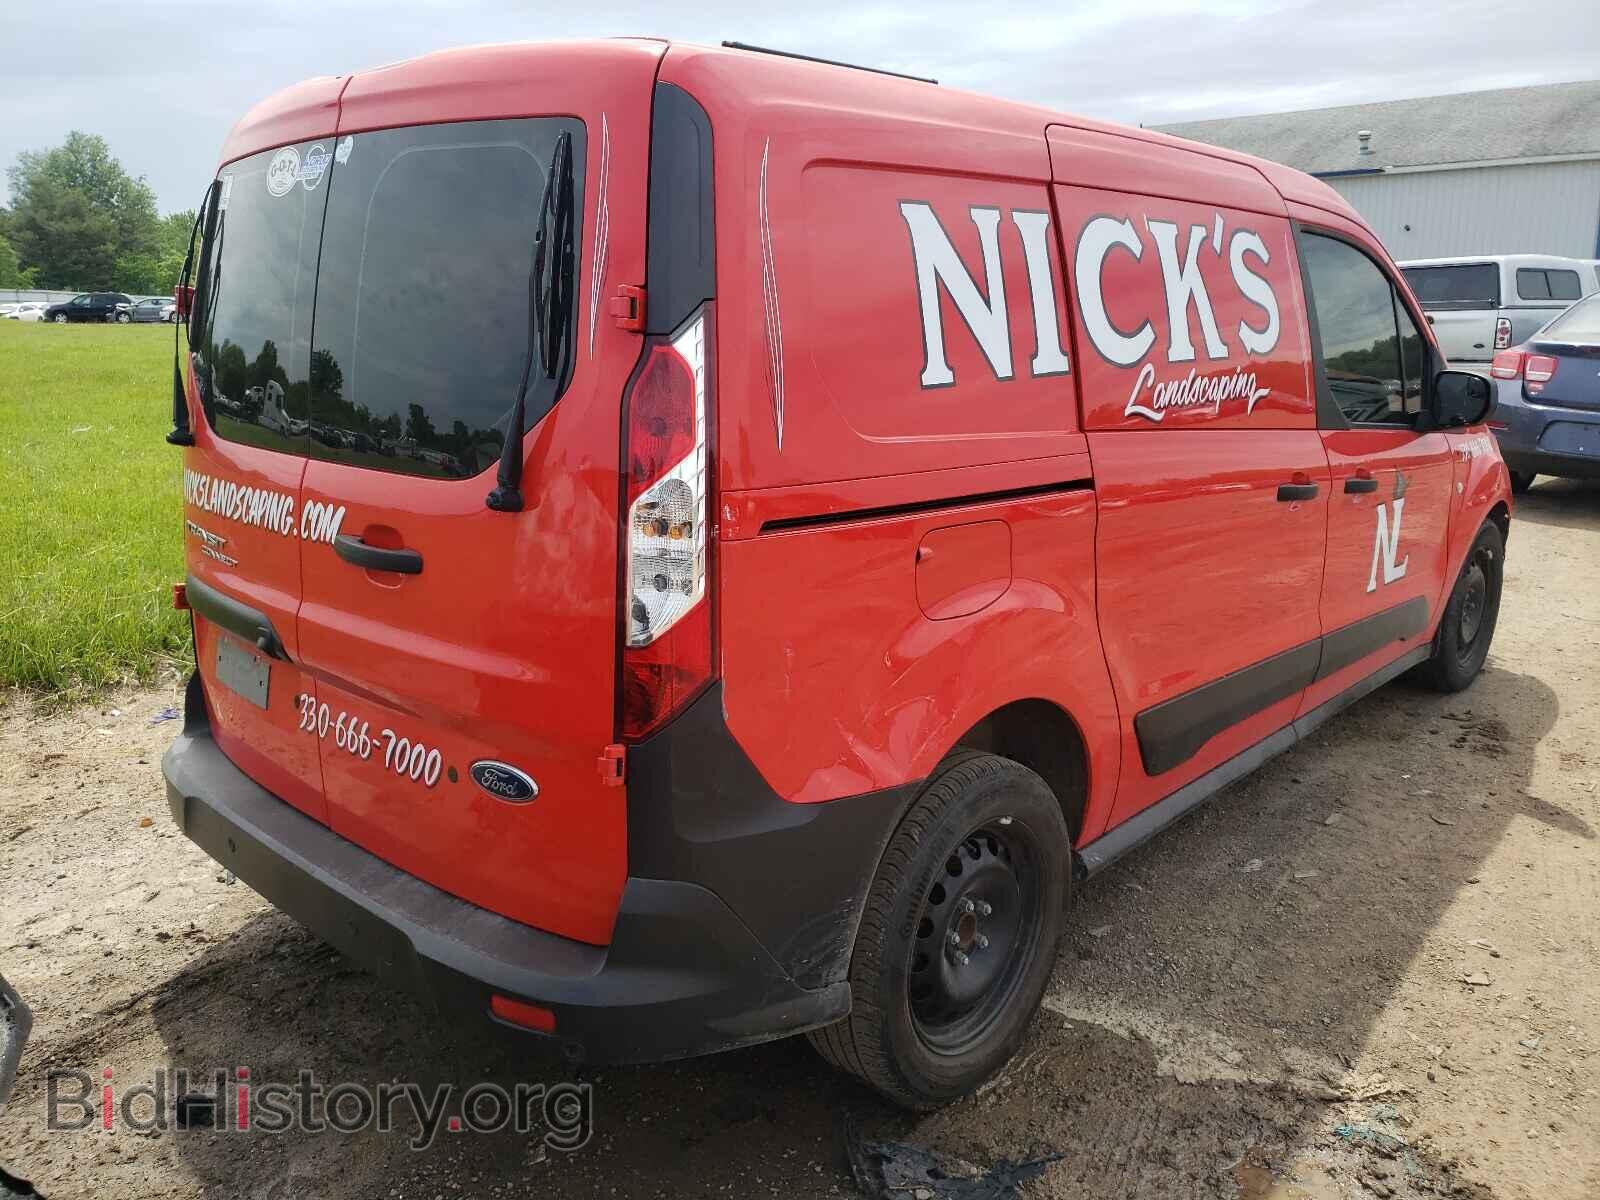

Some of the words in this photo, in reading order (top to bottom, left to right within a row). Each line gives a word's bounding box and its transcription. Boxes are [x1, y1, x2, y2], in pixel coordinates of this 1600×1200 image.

[899, 199, 1280, 388] NICK'S
[1125, 363, 1271, 421] Landscaping
[299, 693, 442, 787] 330-666-7000
